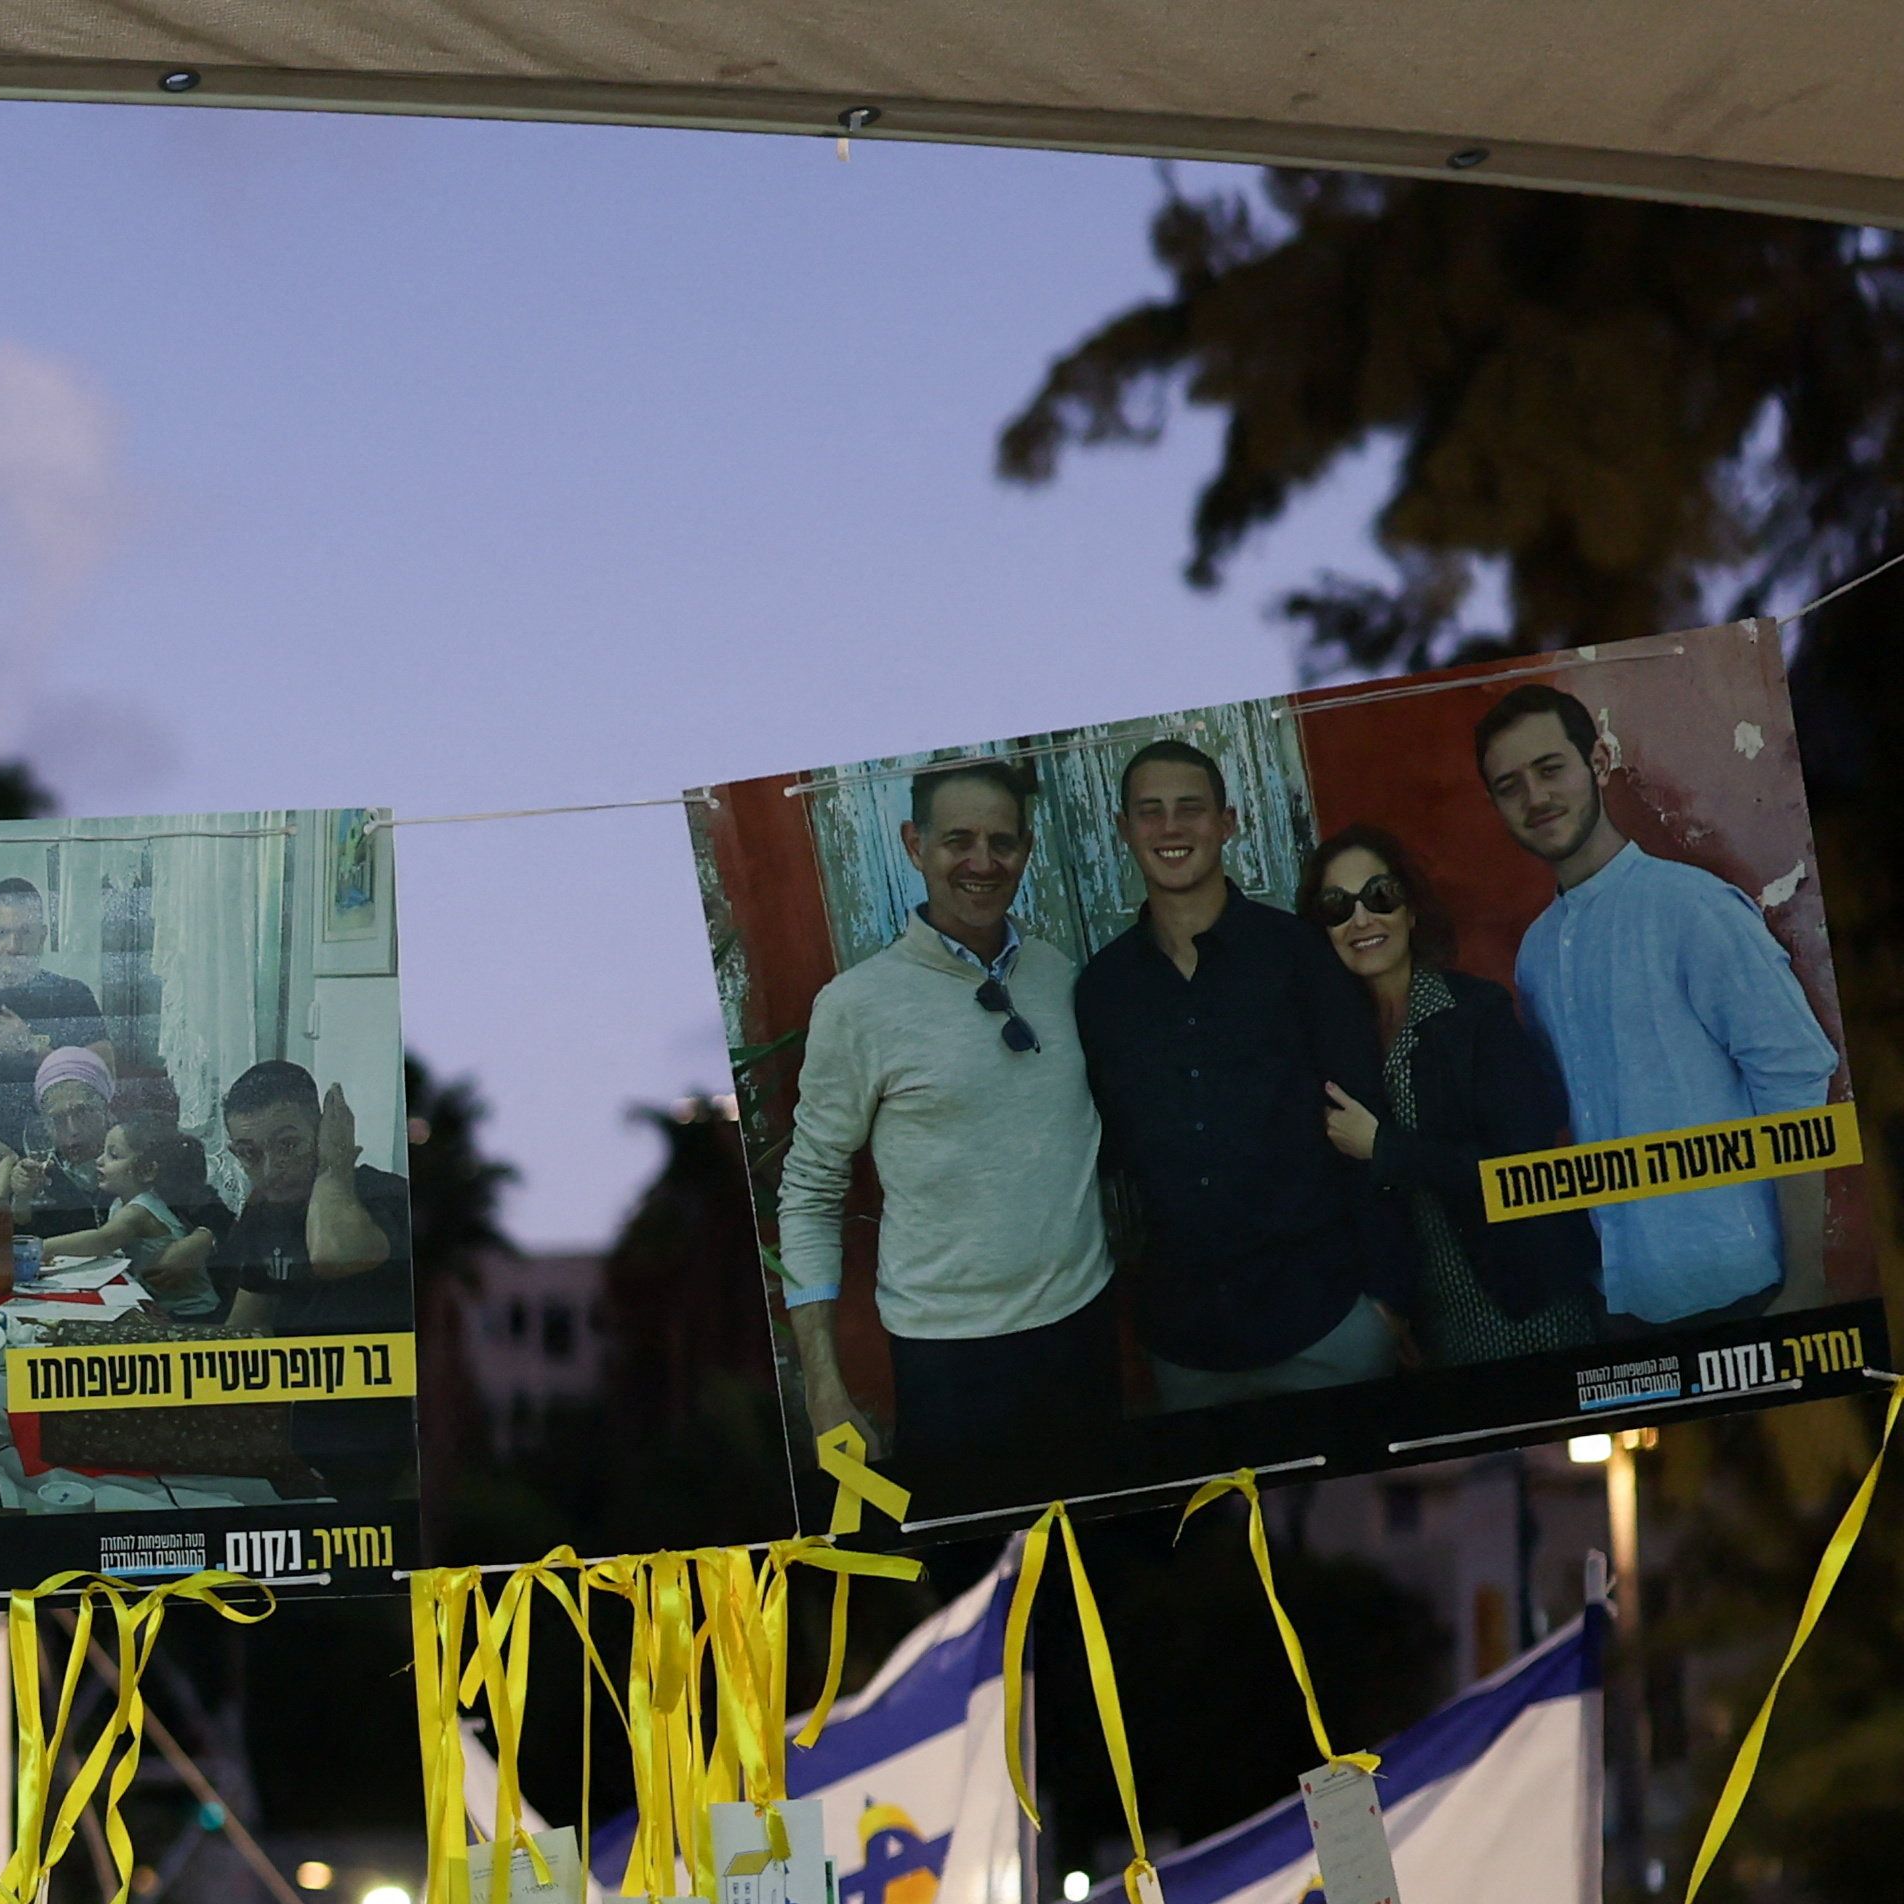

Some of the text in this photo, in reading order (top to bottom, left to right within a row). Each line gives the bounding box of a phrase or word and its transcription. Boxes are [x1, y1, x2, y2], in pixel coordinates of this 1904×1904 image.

[1496, 1116, 1836, 1208] עומר נאוטרה ומשפחתו
[27, 1344, 391, 1400] בר קופרשטיין ומשפחתו
[1613, 1358, 1658, 1381] המשפחות
[1659, 1356, 1678, 1373] מטה
[1692, 1328, 1864, 1394] נחזיר. נקום.
[1631, 1371, 1681, 1395] החטופים
[100, 1533, 205, 1552] מטה המשפחות להחזרת
[215, 1526, 392, 1578] נחזיר. נקום.
[101, 1548, 206, 1572] החטופים והנעדרים
